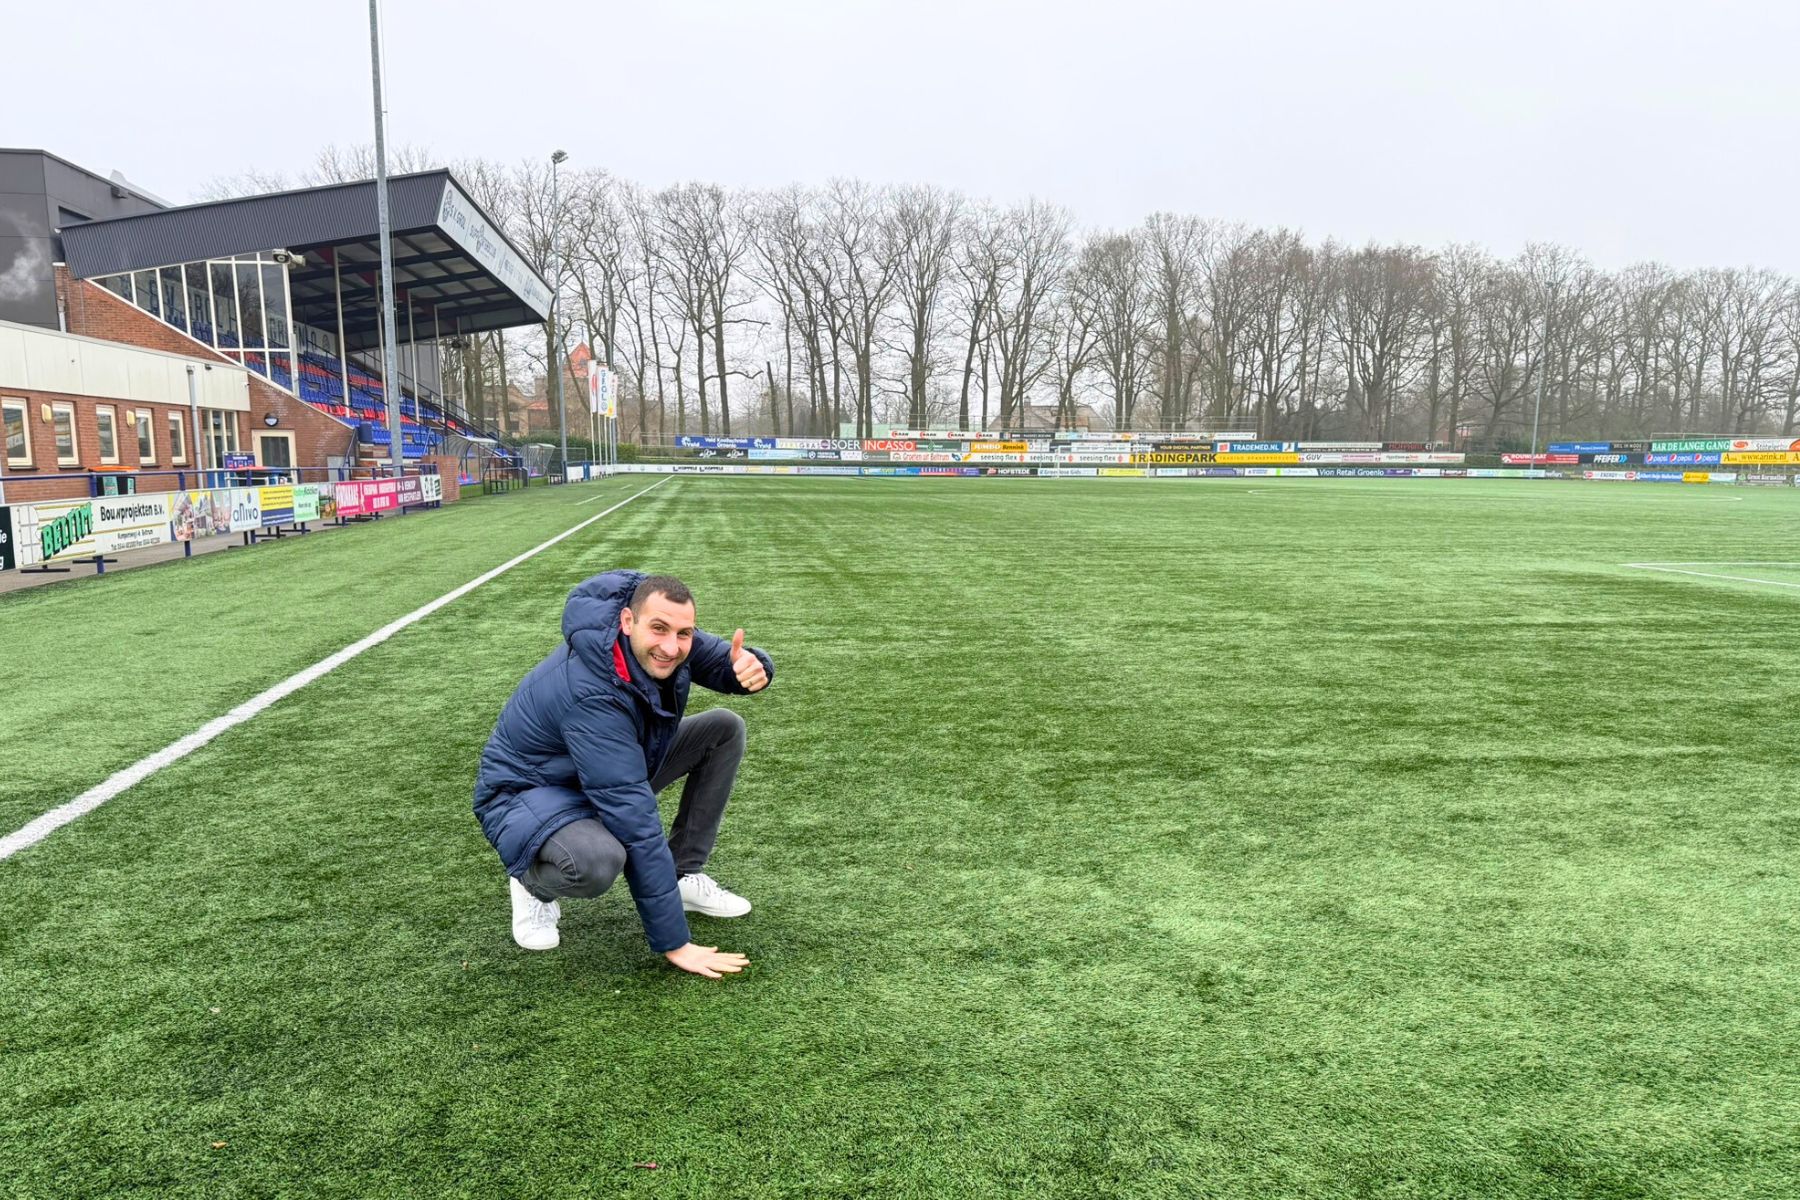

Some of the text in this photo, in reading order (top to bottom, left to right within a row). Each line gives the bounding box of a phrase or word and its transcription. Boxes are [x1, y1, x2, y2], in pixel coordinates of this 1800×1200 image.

[831, 440, 861, 450] SOER
[864, 440, 914, 451] INCASSO
[1652, 441, 1730, 451] BAR DE LANGE GANG
[1130, 453, 1217, 463] TRADINGPARK
[1593, 455, 1620, 463] PFEIFER
[100, 503, 153, 524] Bouwprojekten
